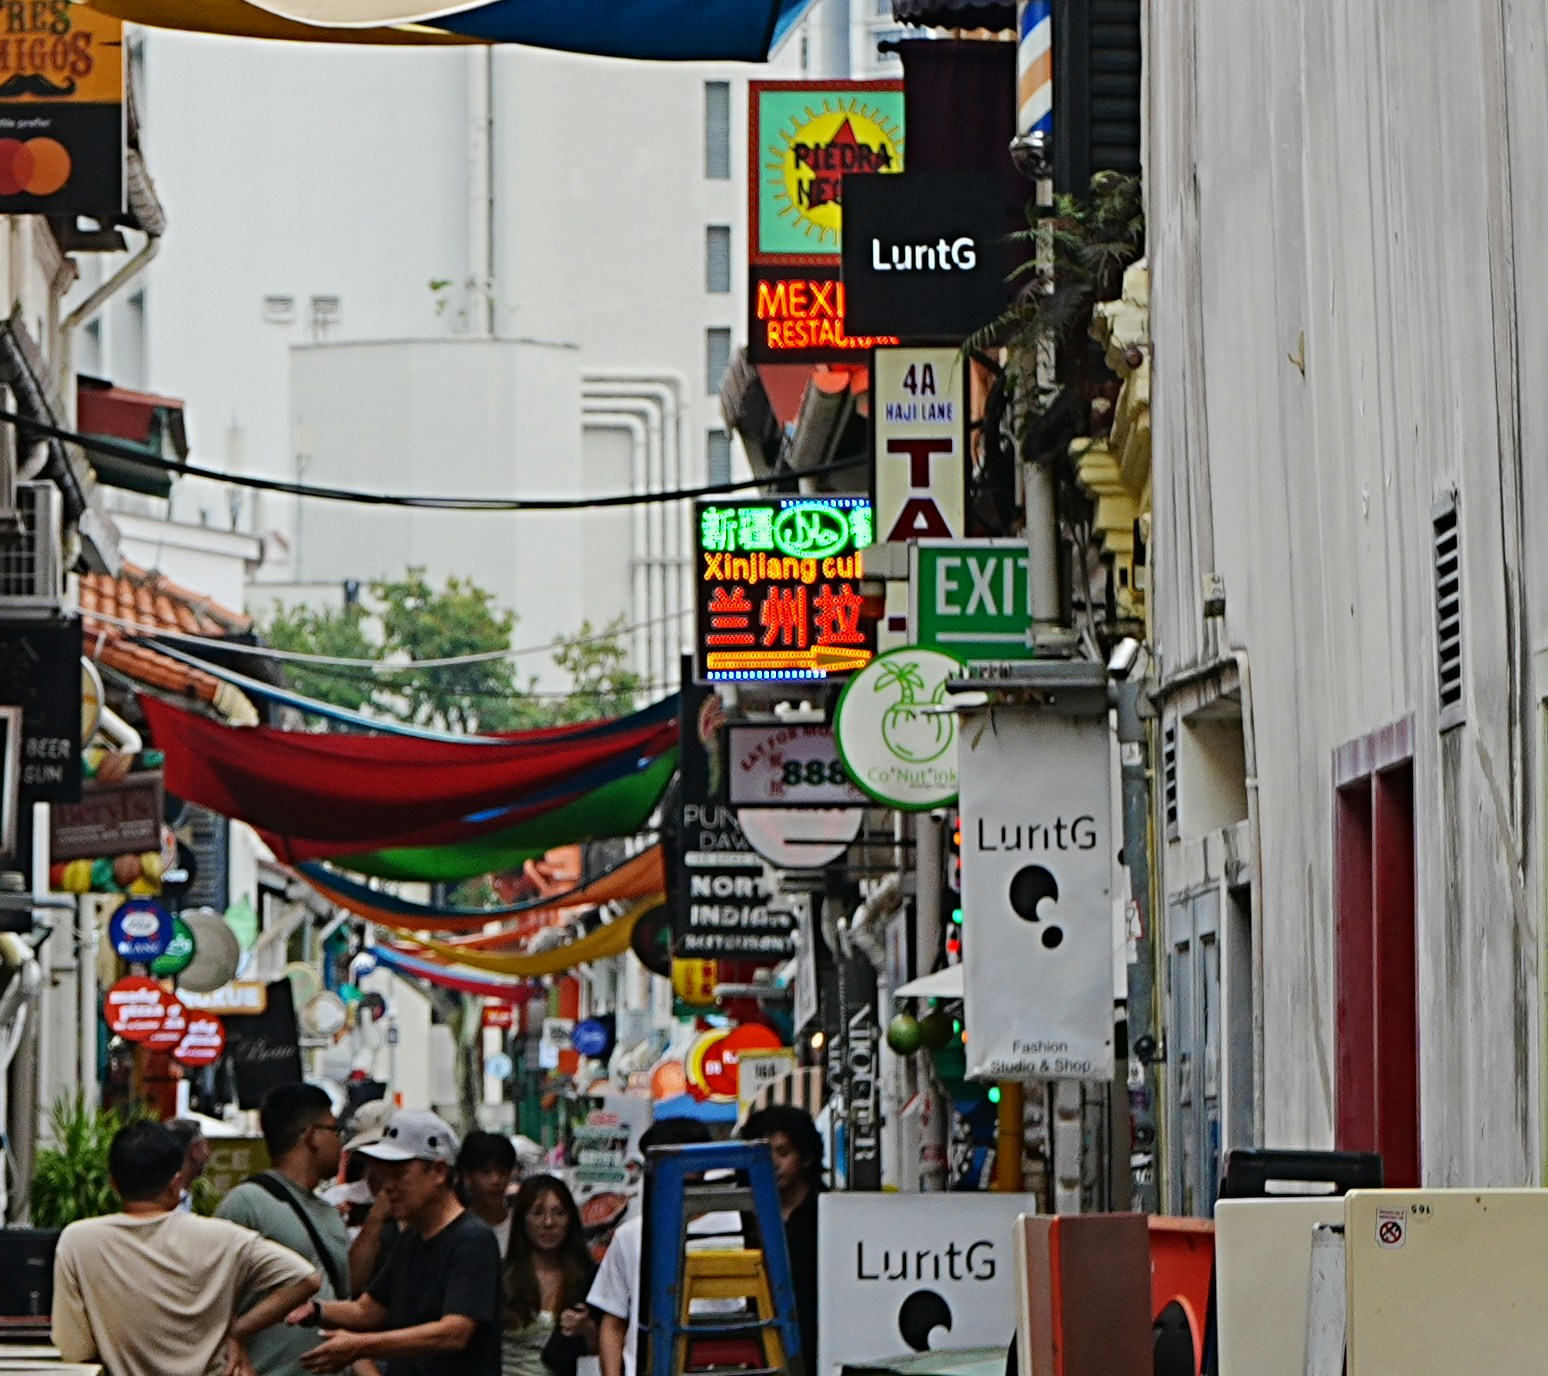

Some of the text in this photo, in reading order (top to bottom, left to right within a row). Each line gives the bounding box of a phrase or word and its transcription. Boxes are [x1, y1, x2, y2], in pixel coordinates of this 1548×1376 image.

[793, 143, 892, 169] PIEDRA
[902, 363, 936, 396] 4A
[885, 401, 953, 423] HAJI LANE
[704, 552, 817, 584] Xinjiang
[707, 584, 865, 647] 兰州拉
[1012, 1040, 1068, 1054] Fashion
[991, 1059, 1091, 1075] Studio & Shop
